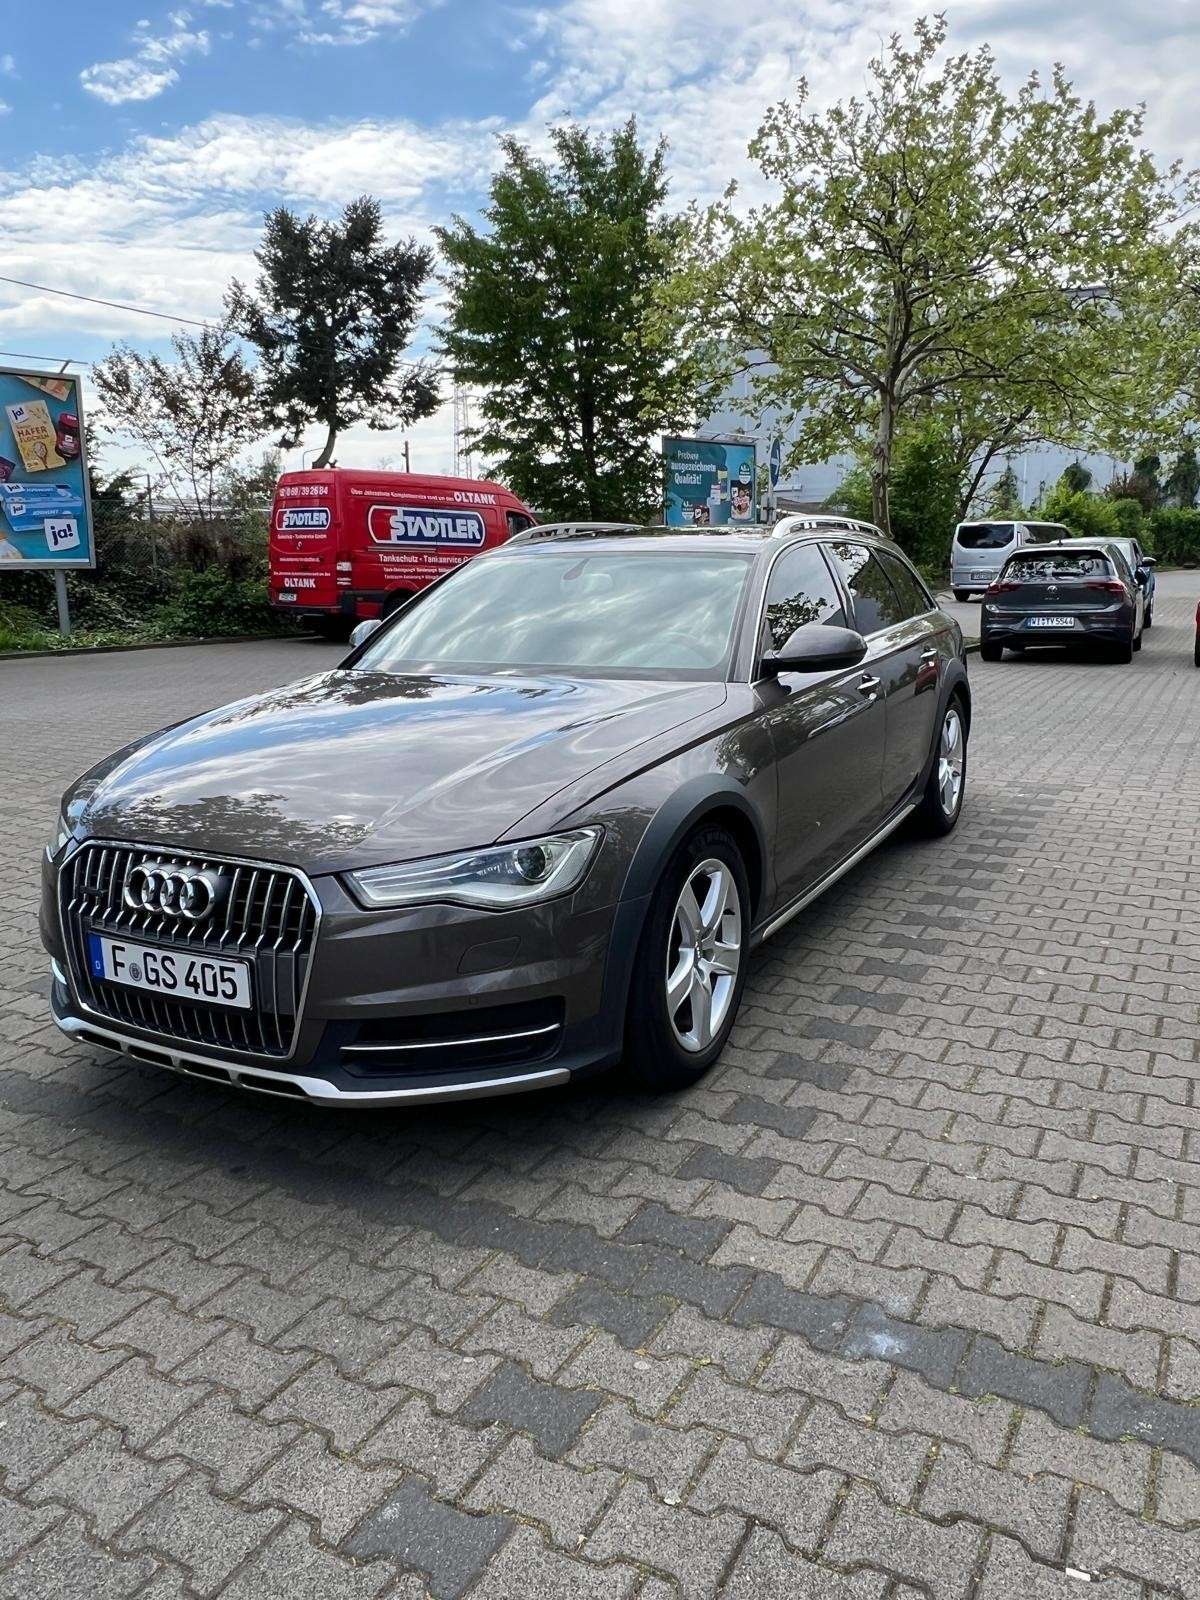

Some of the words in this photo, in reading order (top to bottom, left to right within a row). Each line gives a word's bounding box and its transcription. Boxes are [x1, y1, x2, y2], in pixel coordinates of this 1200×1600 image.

[12, 407, 24, 420] ja!
[17, 426, 47, 437] HAFER
[674, 473, 702, 485] Qualität!
[283, 511, 328, 527] STADTLER
[390, 512, 482, 540] STADTLER
[50, 524, 74, 546] ja!
[379, 554, 418, 564] Tankschutz
[111, 944, 126, 977] F
[143, 951, 178, 990] GS
[184, 960, 238, 1000] 405
